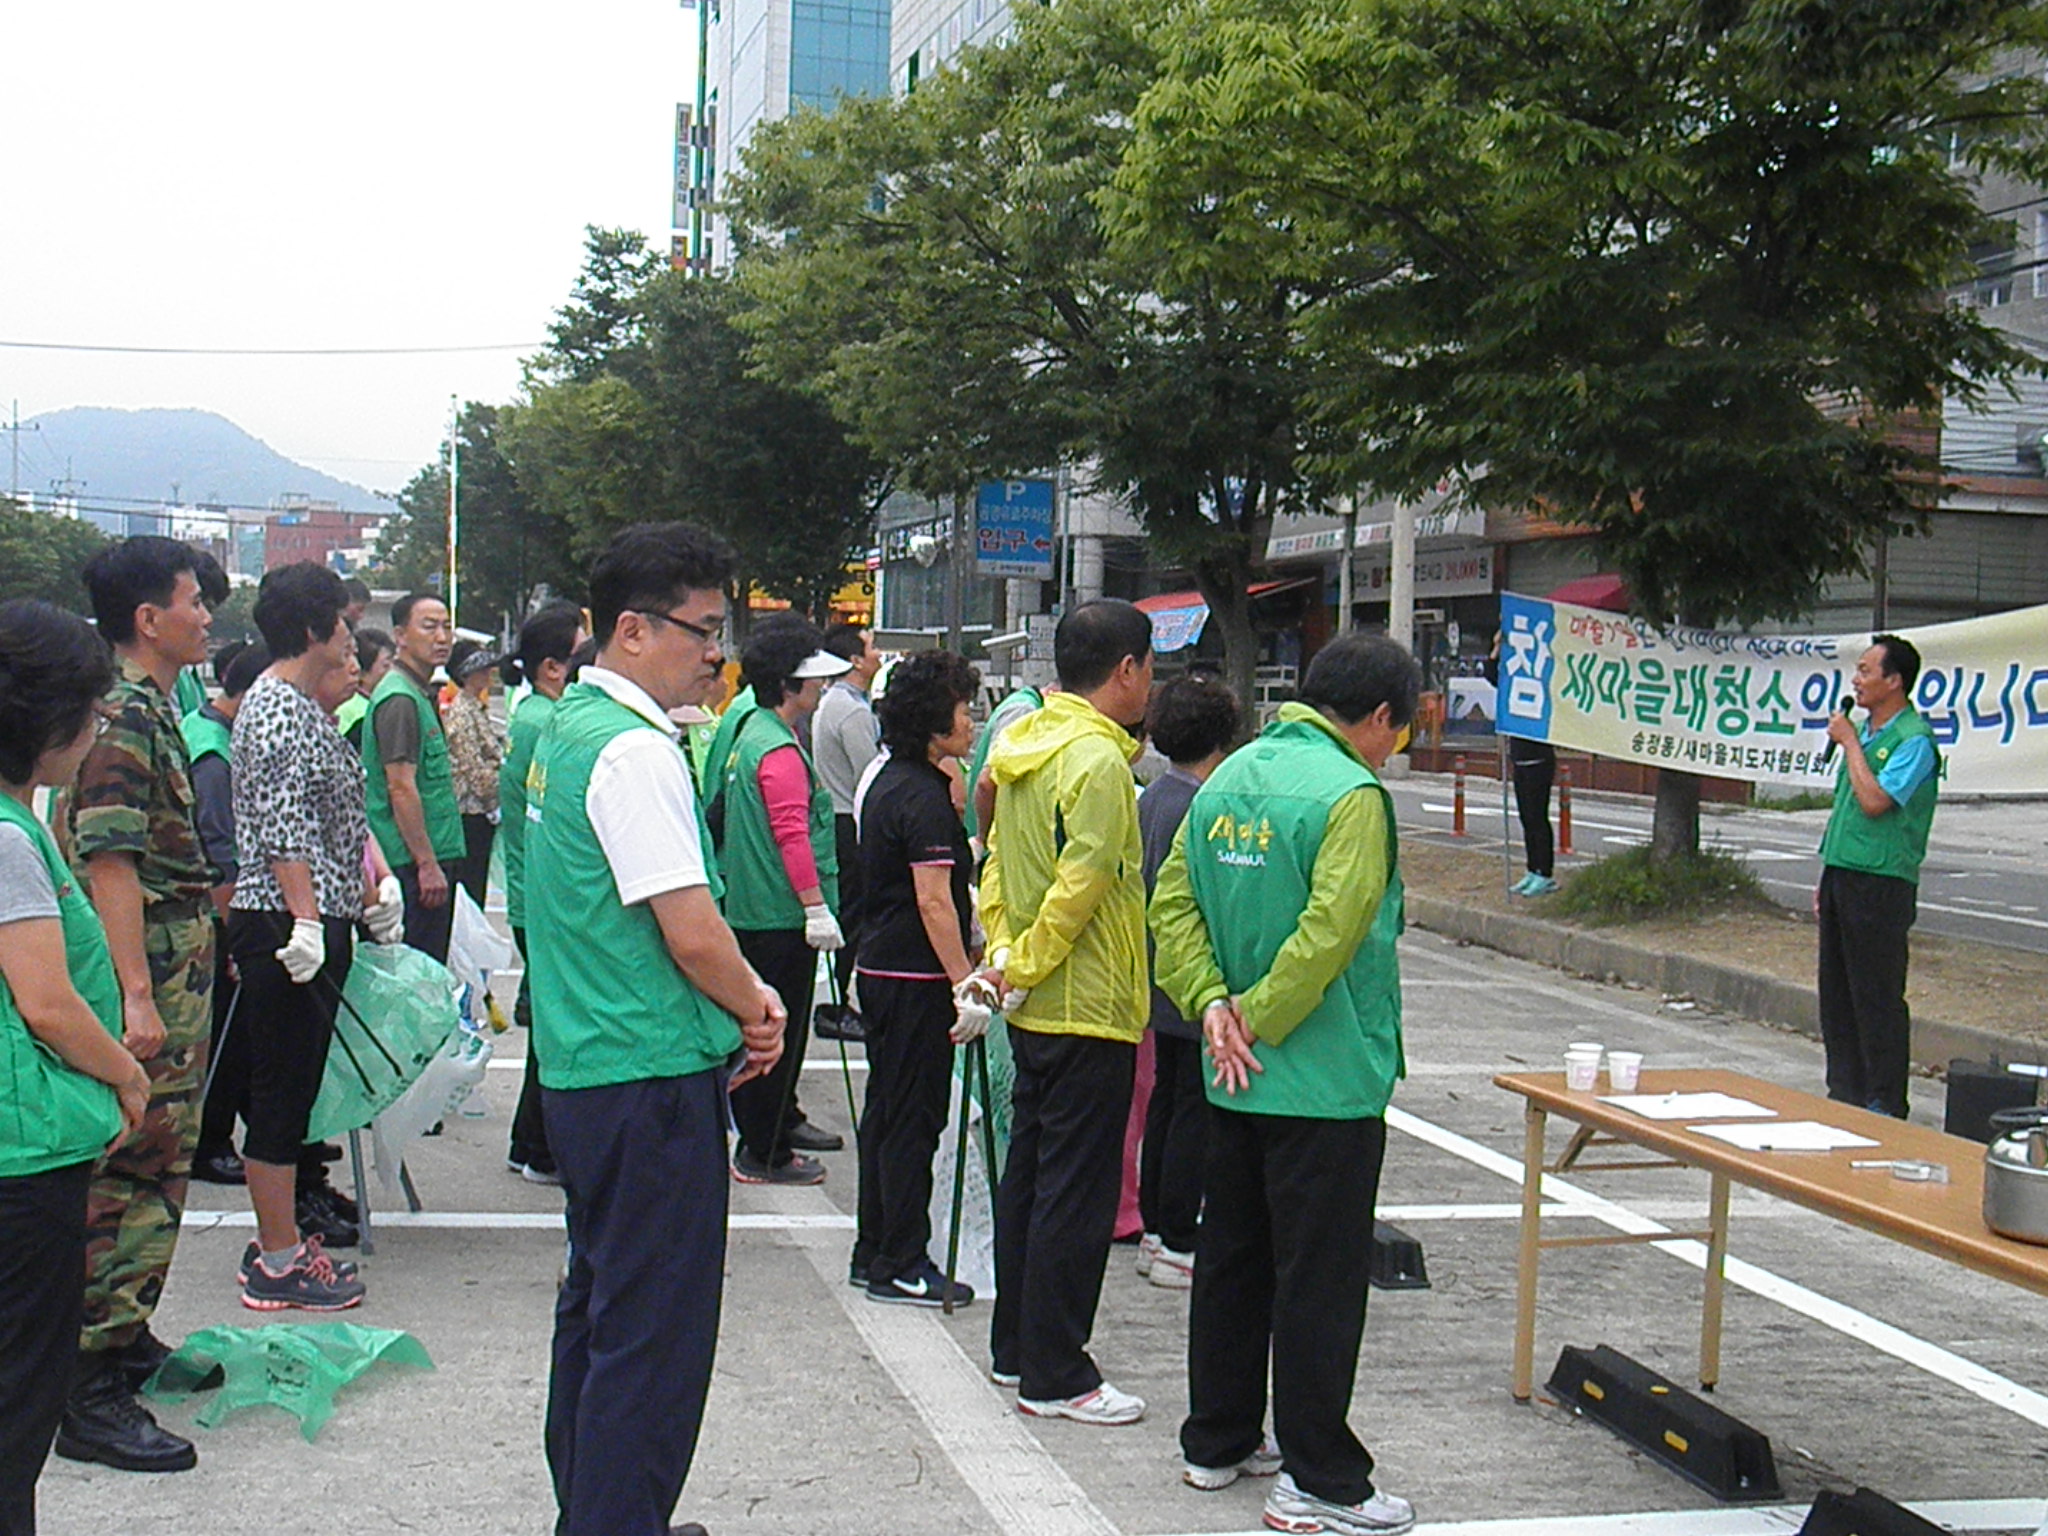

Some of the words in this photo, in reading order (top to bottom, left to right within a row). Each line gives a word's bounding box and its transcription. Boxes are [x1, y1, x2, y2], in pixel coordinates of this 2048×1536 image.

[1005, 481, 1026, 502] P
[979, 527, 1027, 553] 입구
[1506, 613, 1551, 720] 참
[1207, 813, 1274, 851] 새마을
